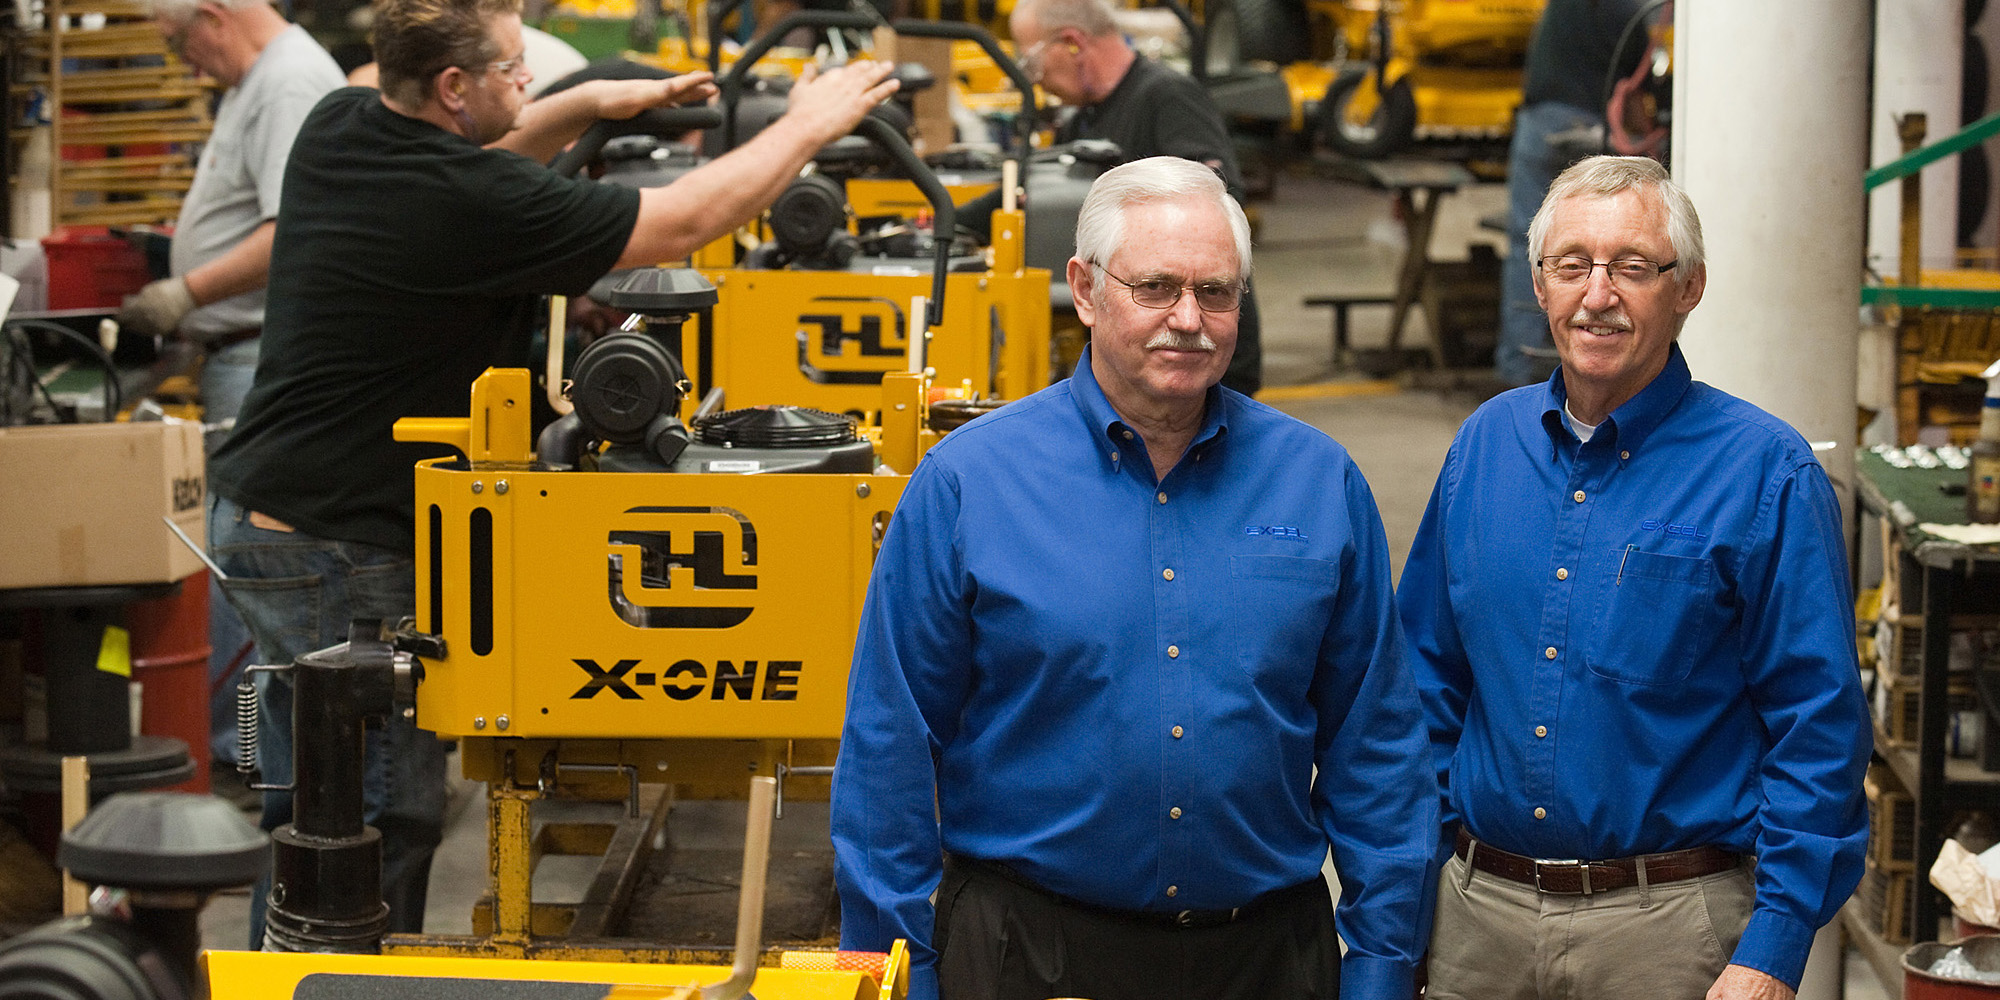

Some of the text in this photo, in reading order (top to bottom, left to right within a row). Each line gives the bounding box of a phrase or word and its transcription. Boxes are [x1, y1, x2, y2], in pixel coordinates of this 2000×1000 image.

[1245, 526, 1309, 539] EXCEL
[1641, 519, 1707, 538] EXCEL
[569, 658, 803, 701] X-ONE
